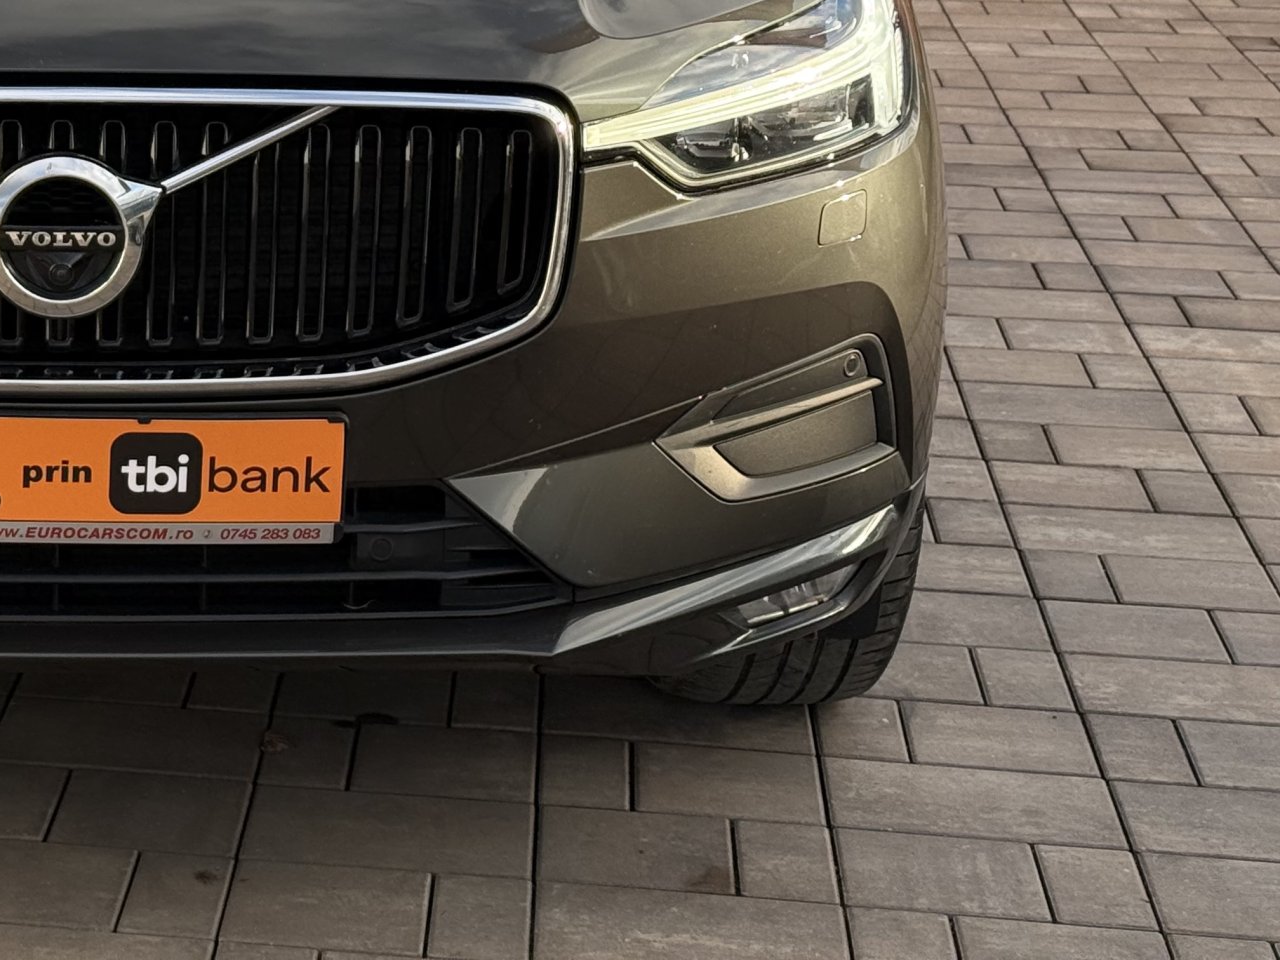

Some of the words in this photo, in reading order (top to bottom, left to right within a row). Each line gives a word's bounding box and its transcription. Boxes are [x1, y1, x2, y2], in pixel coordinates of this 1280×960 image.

[5, 231, 117, 247] VOLVO
[22, 460, 93, 489] prin
[120, 453, 190, 494] tbi
[207, 455, 332, 493] bank
[219, 527, 257, 540] 0745
[260, 527, 289, 540] 283
[292, 527, 321, 540] 083
